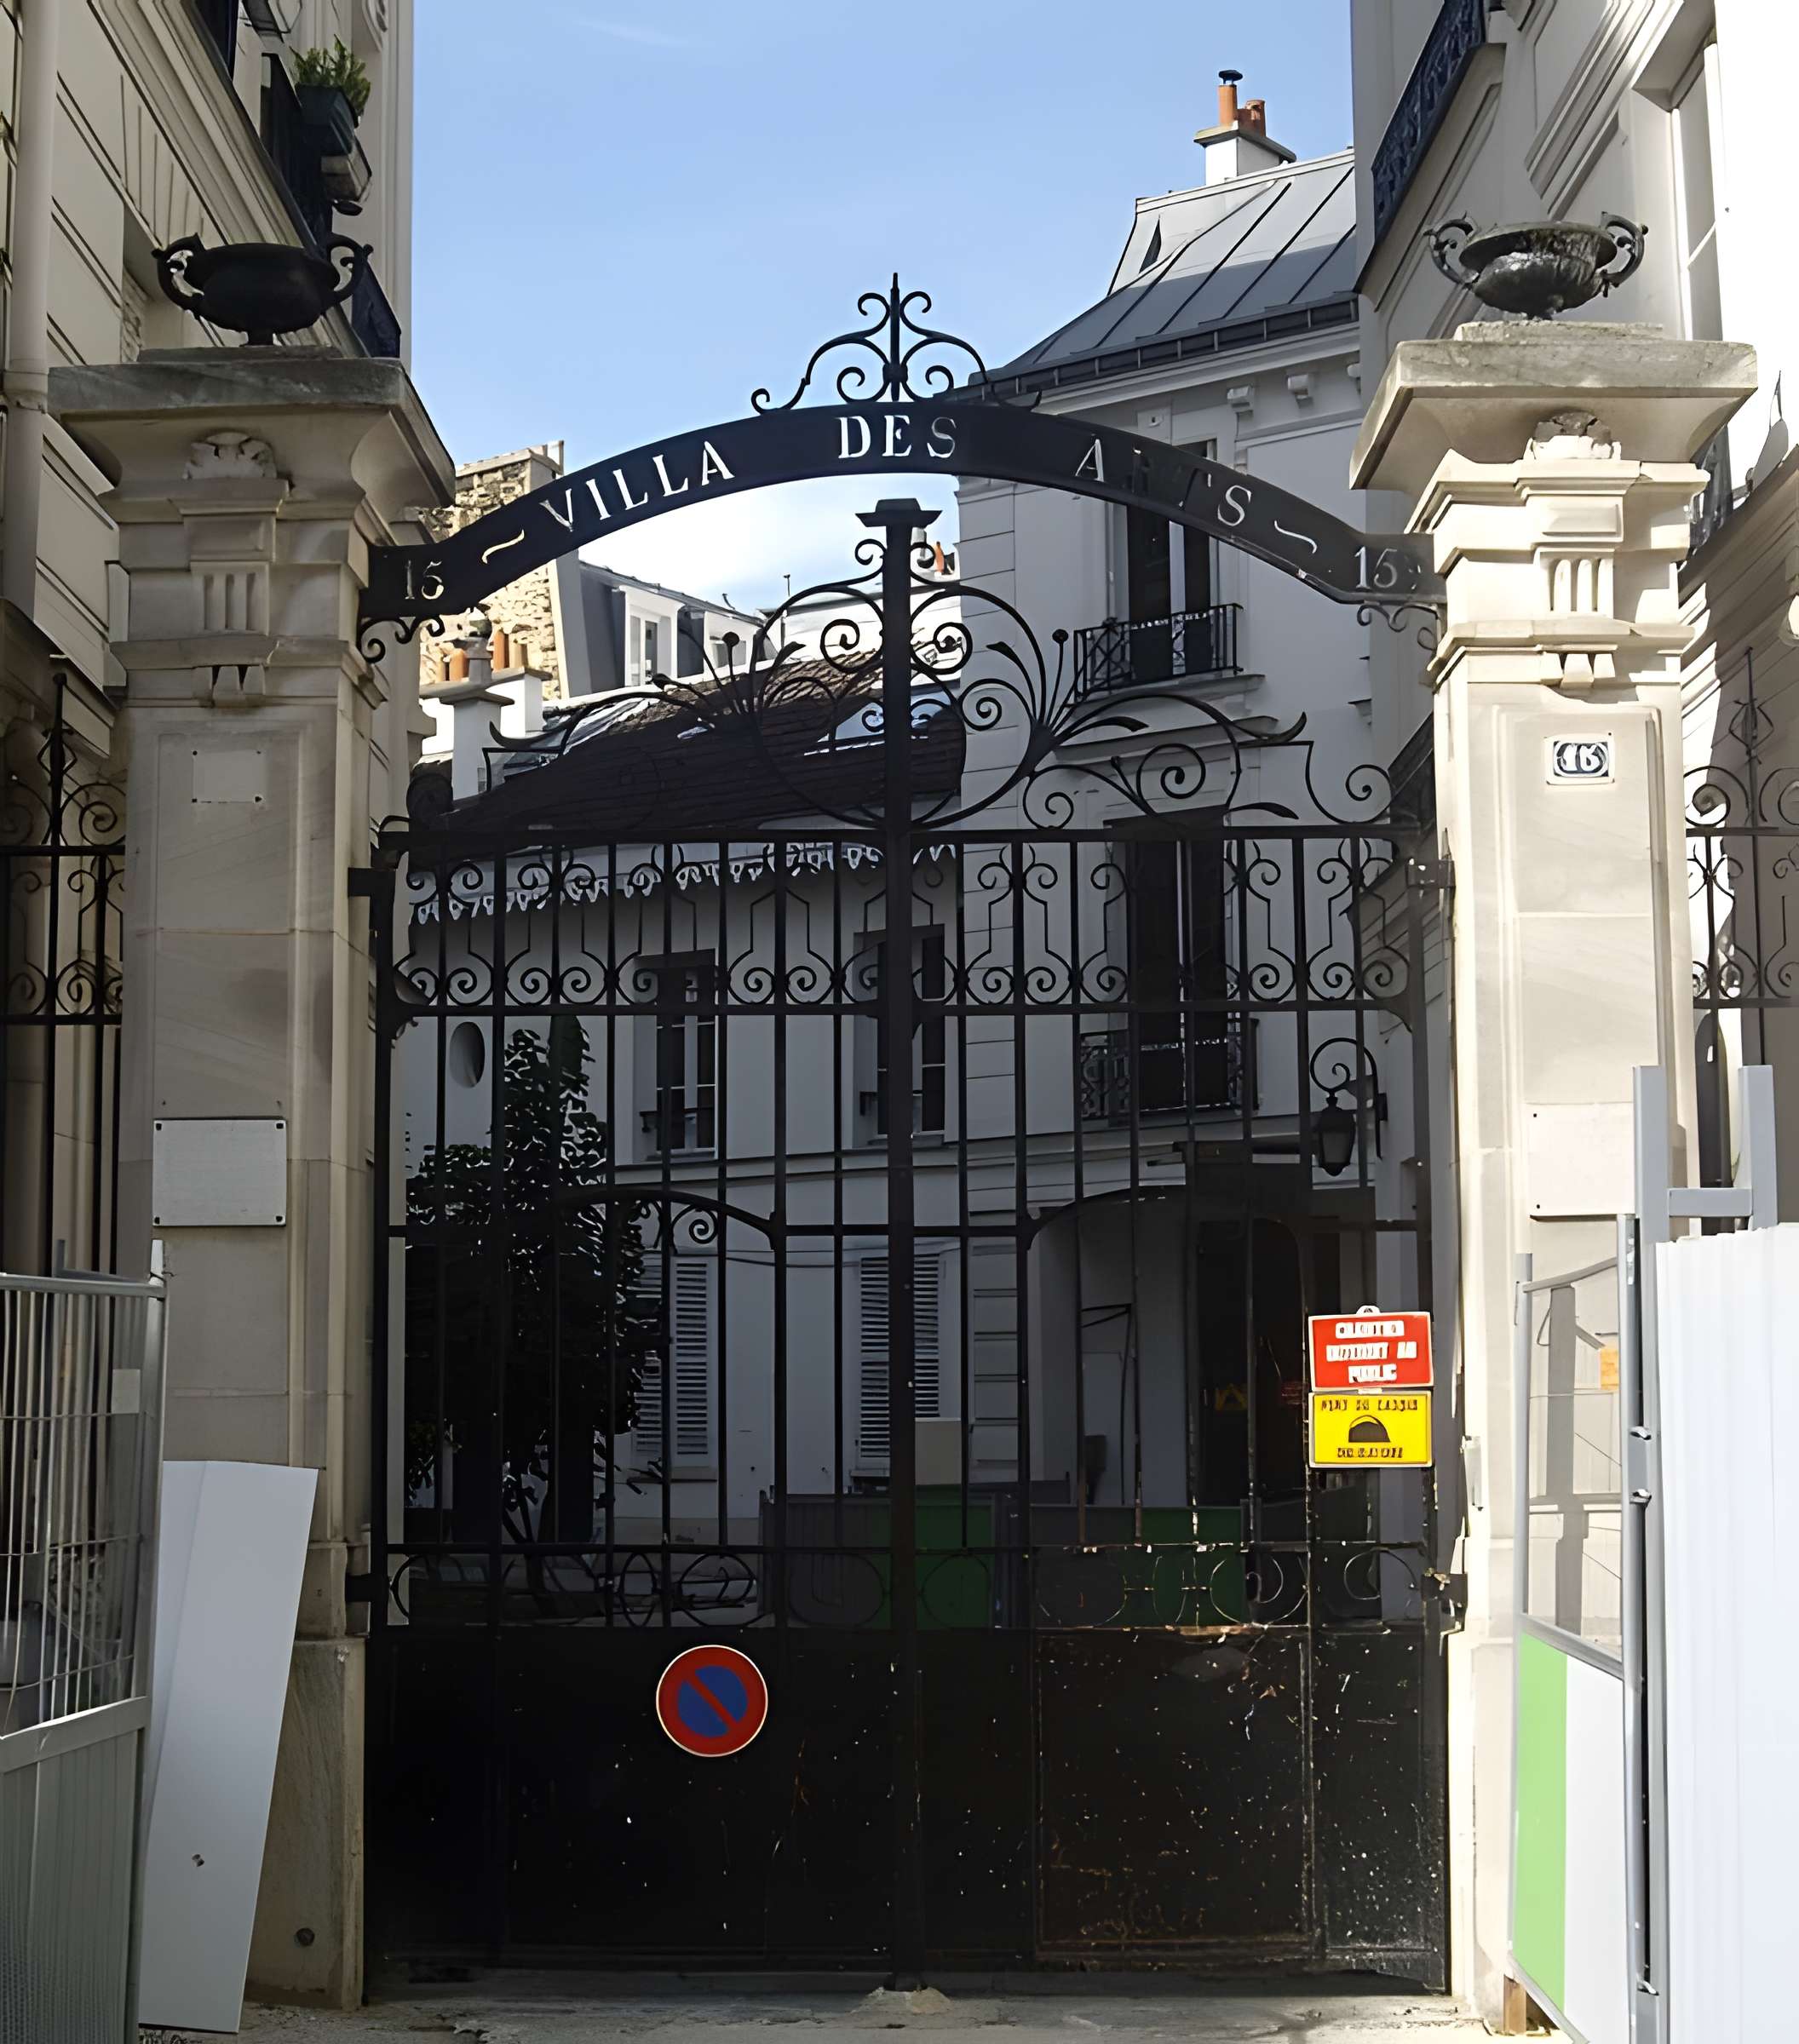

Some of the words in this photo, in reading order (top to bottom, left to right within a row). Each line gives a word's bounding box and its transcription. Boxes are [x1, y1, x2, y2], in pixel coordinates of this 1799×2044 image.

[405, 560, 445, 600] 15
[539, 439, 735, 533] VILLA
[836, 414, 957, 459] DES
[1354, 545, 1398, 589] 15
